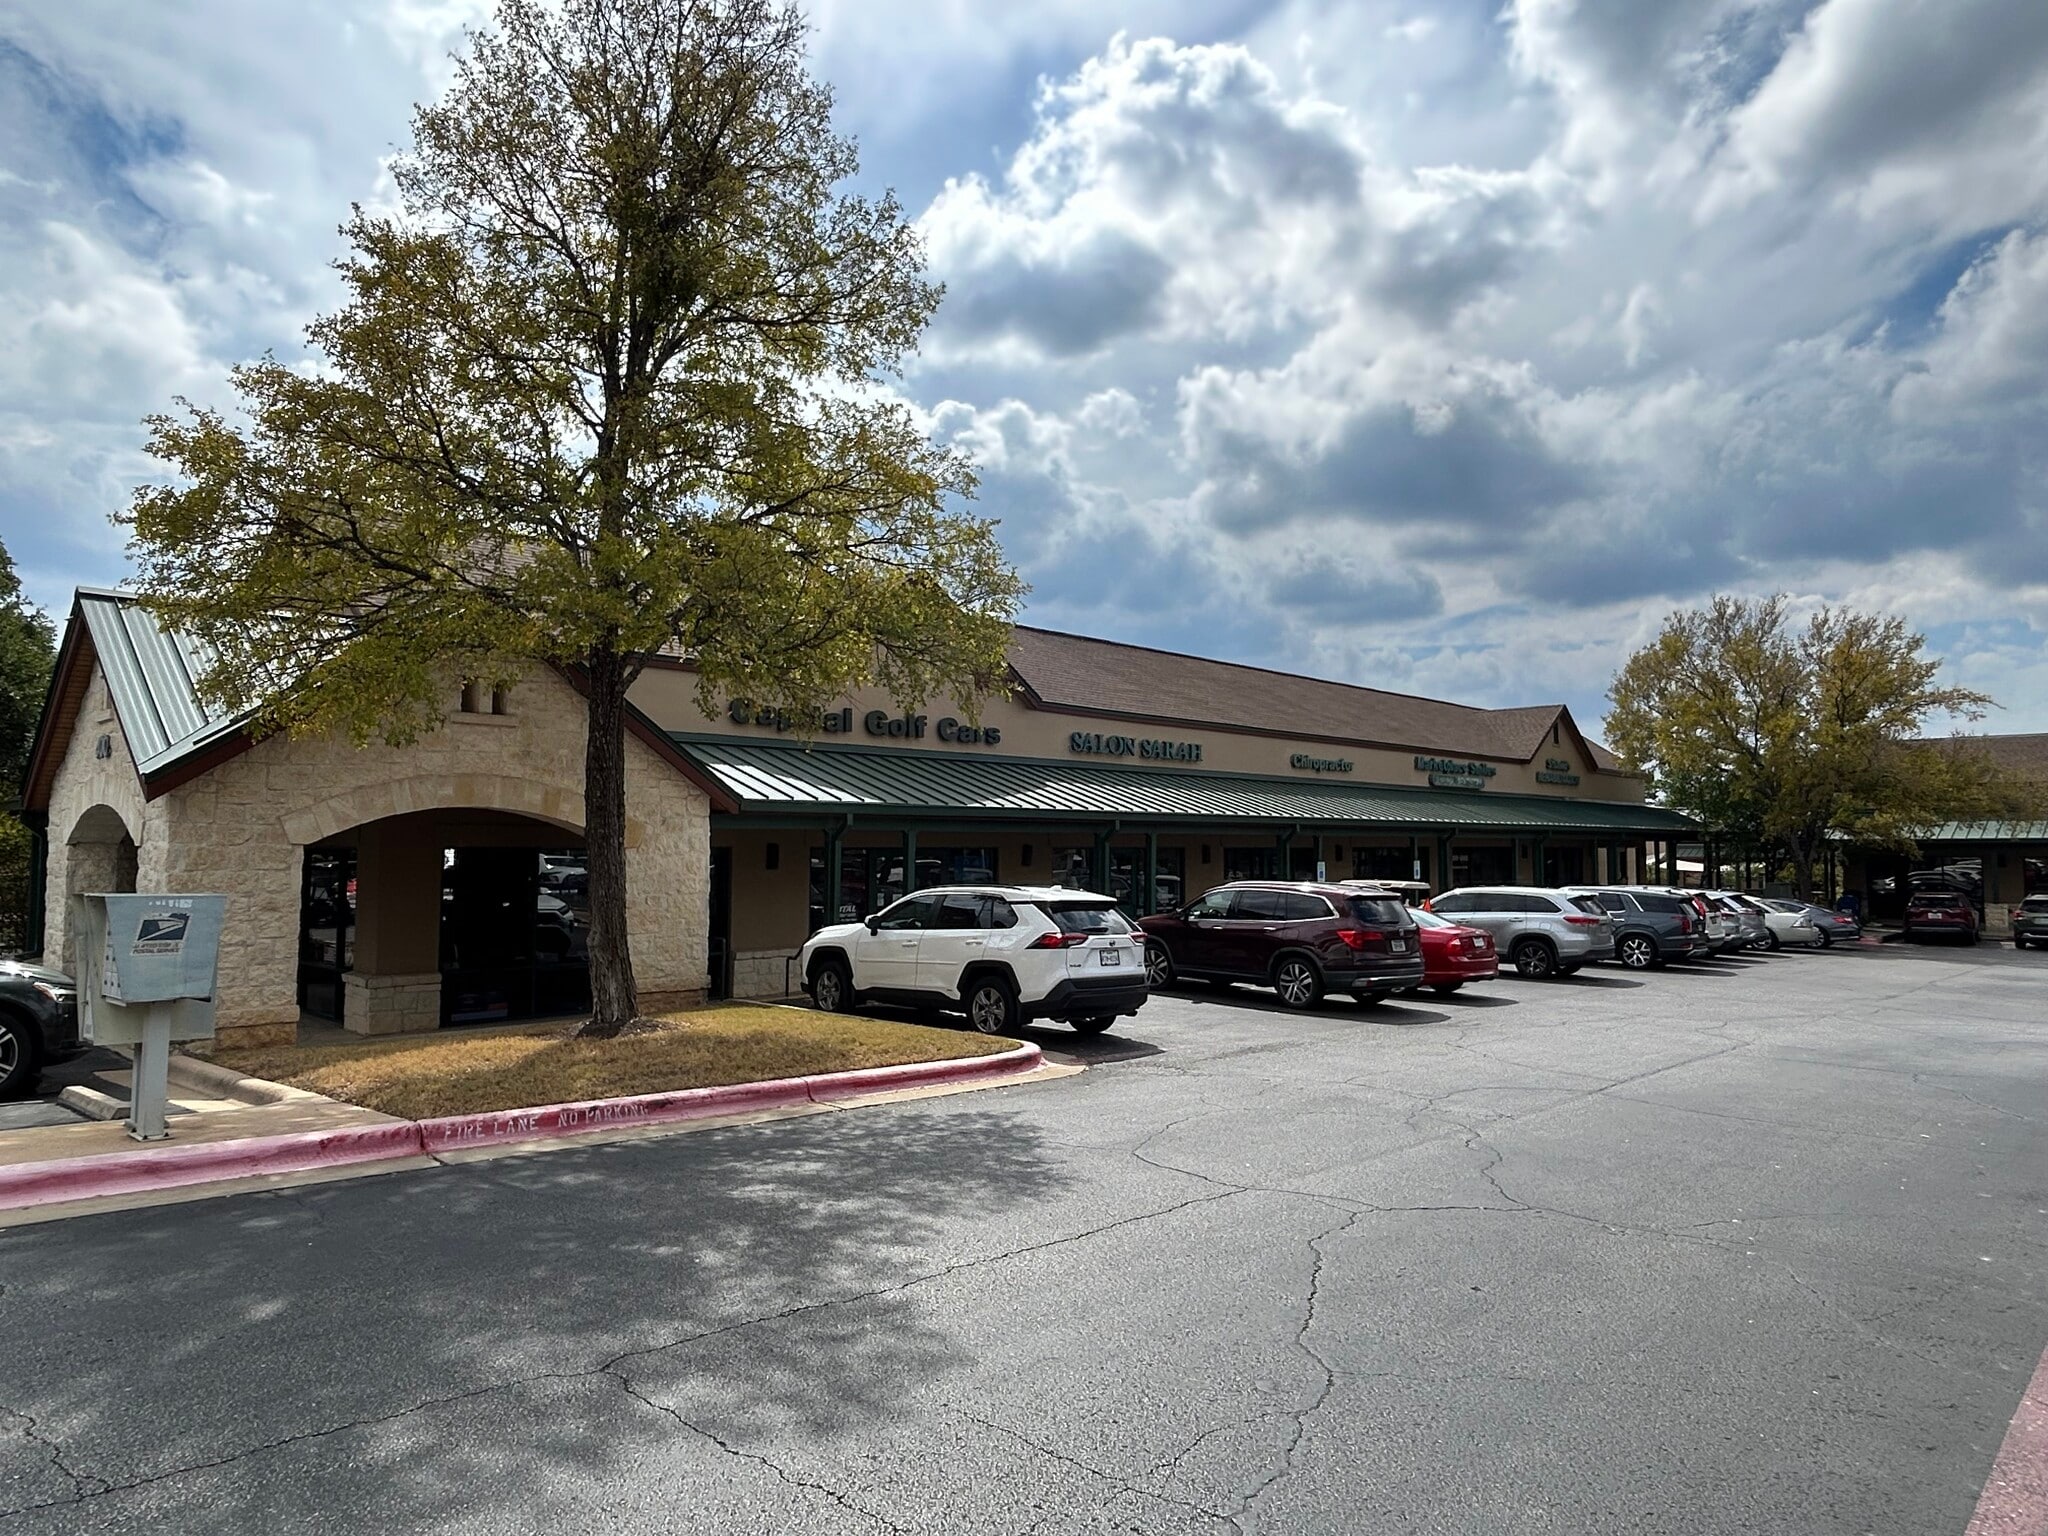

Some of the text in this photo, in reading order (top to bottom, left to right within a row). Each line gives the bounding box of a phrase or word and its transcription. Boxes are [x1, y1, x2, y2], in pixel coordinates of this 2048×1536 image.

[730, 698, 1001, 744] Capal Golf Cars
[1070, 732, 1203, 761] SALON SARAH
[444, 1121, 486, 1142] FIRE
[493, 1115, 539, 1135] LANE
[558, 1110, 579, 1128] NO
